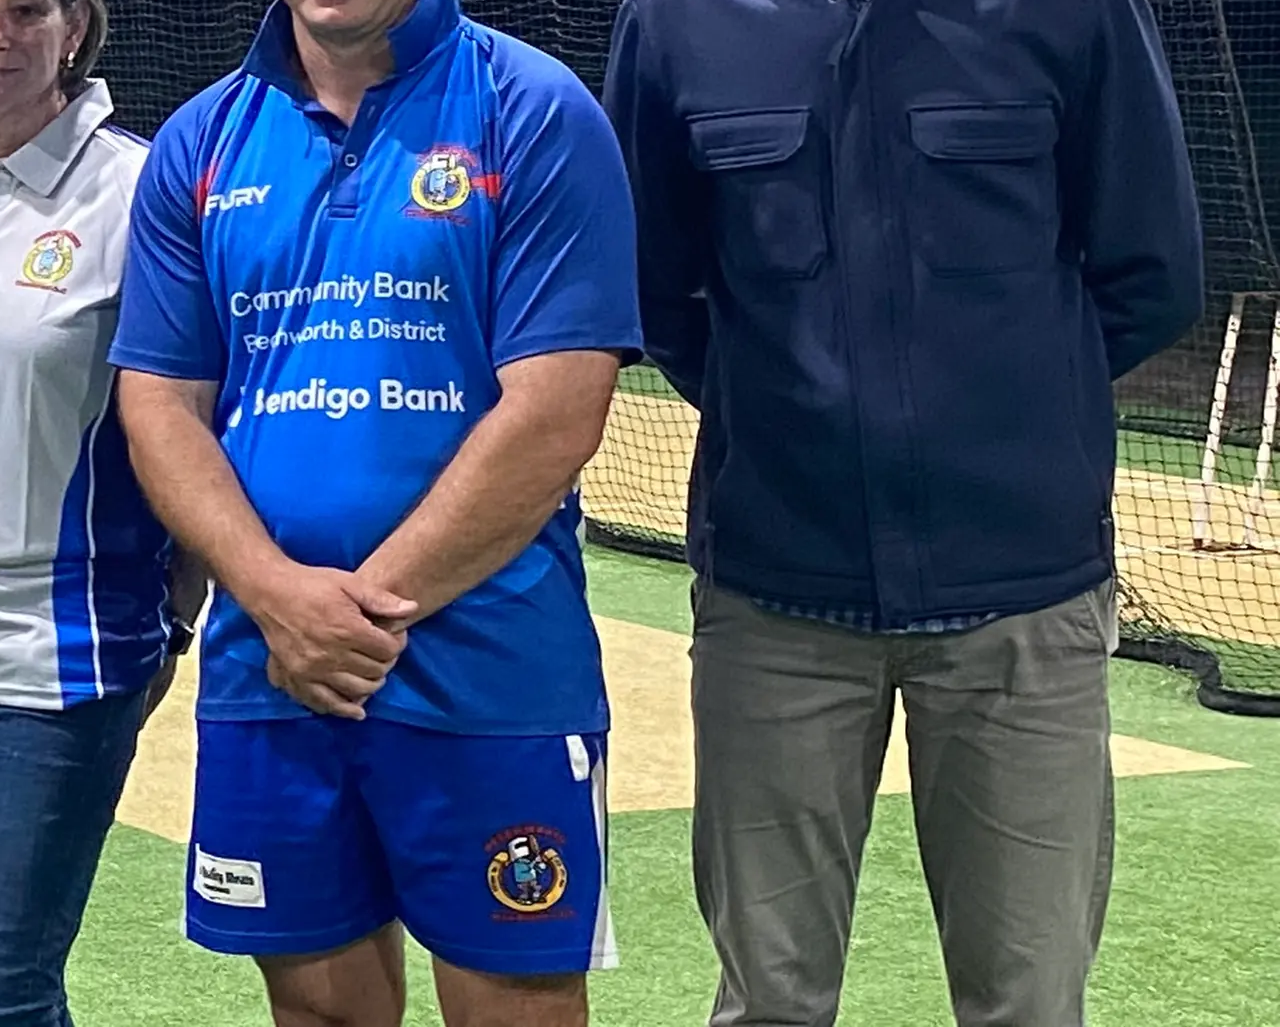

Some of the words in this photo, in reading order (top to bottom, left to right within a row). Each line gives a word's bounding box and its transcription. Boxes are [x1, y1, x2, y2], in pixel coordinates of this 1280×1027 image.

[205, 184, 272, 217] FURY
[374, 271, 450, 303] Bank
[349, 319, 364, 340] &
[368, 317, 446, 342] District
[379, 378, 466, 413] Bank
